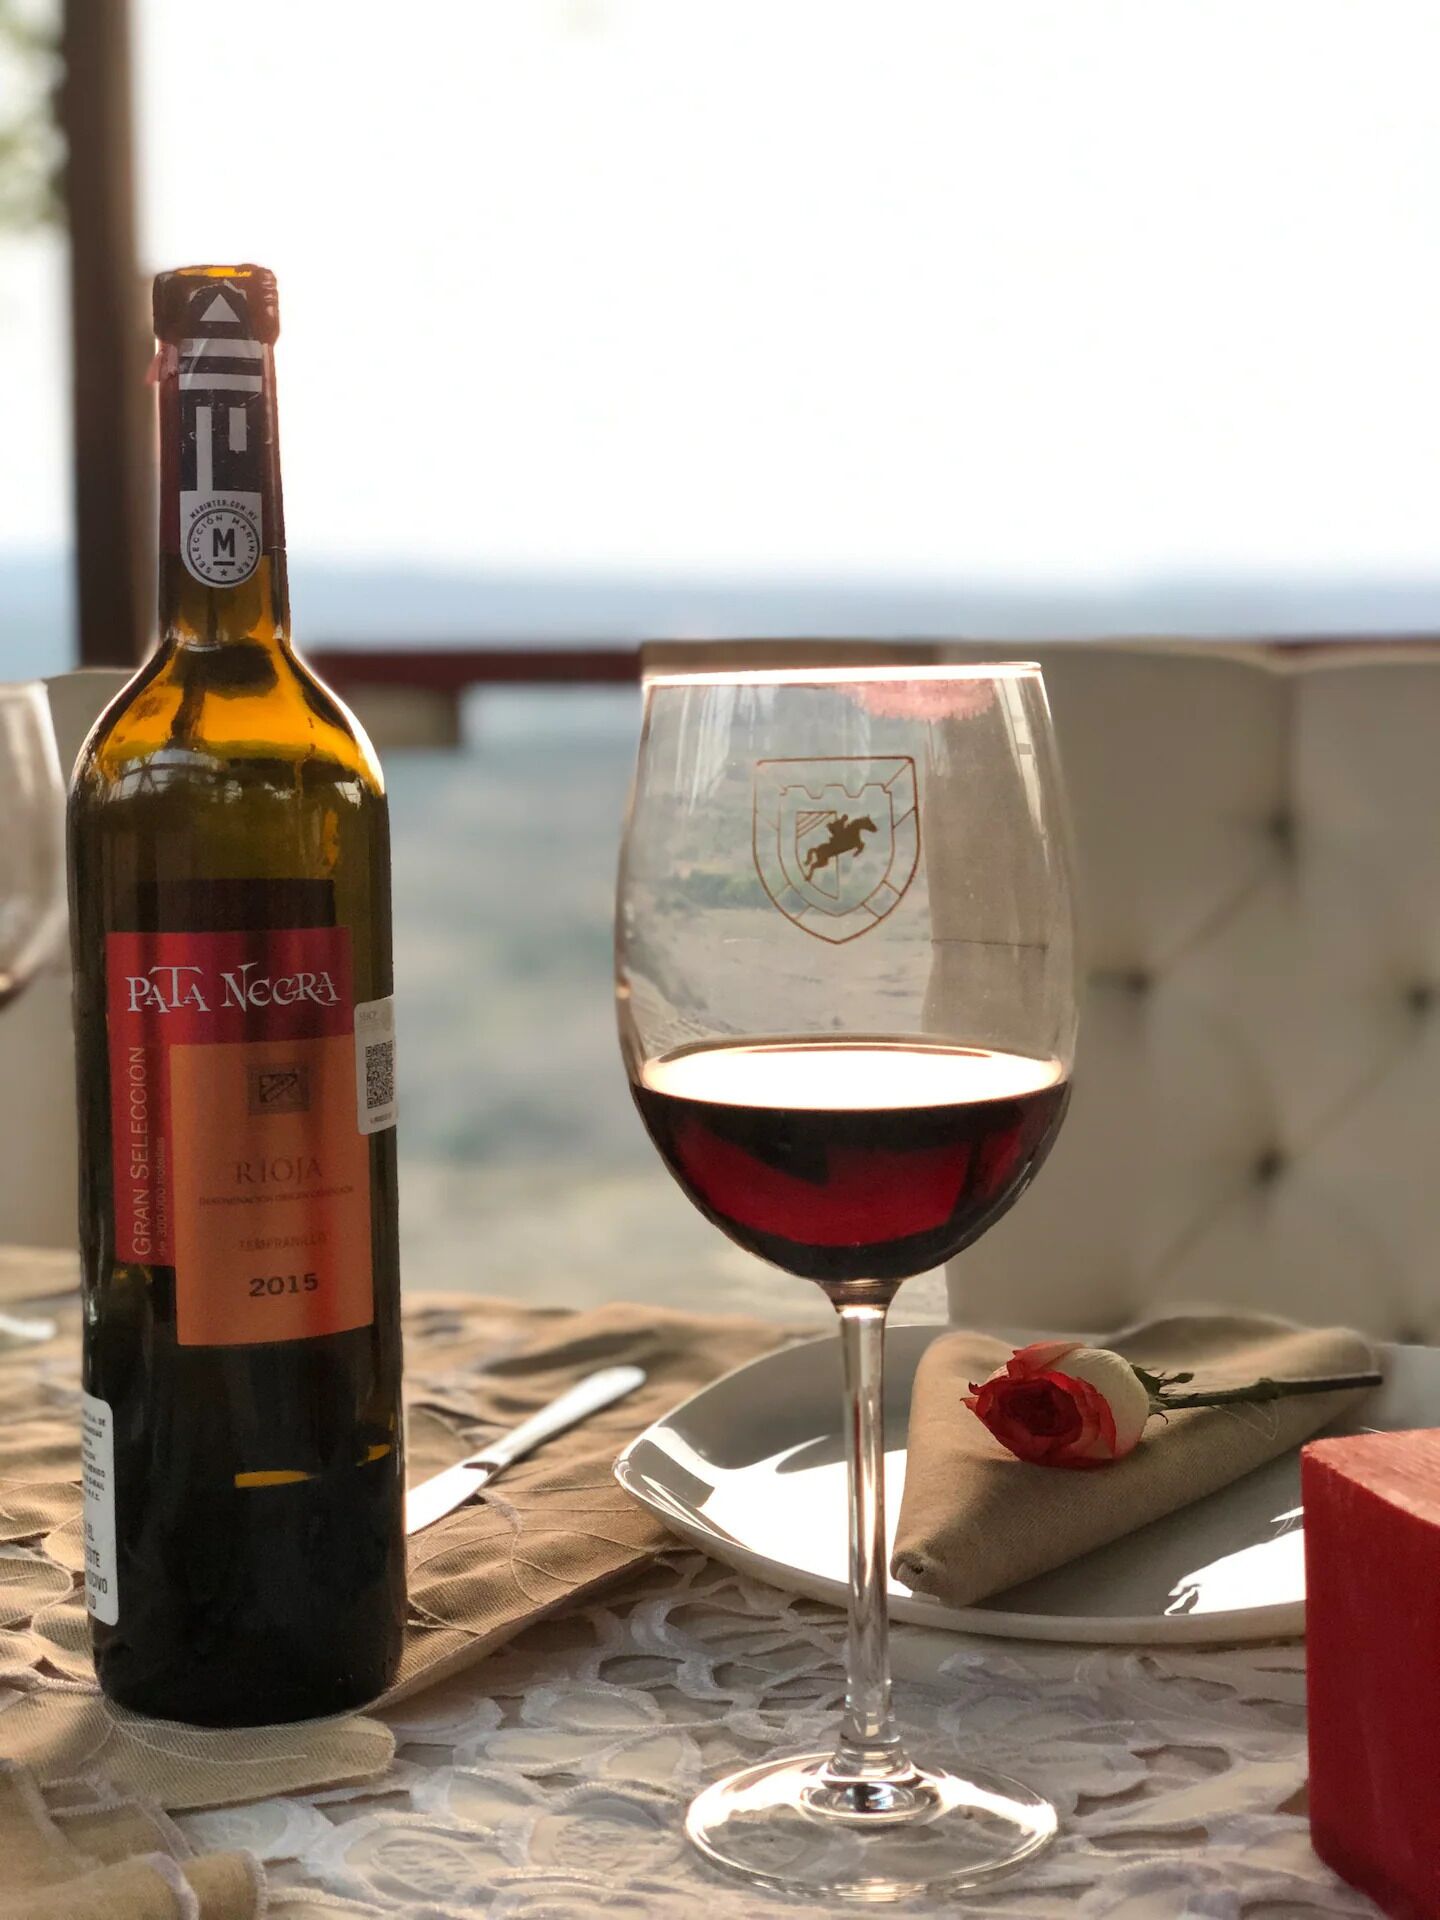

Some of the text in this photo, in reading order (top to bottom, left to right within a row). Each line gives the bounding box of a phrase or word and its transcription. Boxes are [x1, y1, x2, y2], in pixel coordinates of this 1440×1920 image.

[212, 528, 236, 558] M
[125, 961, 341, 1013] PATA NEGRA
[235, 1157, 323, 1184] RIOJA
[132, 1188, 152, 1256] GRAN
[249, 1272, 318, 1297] 2015
